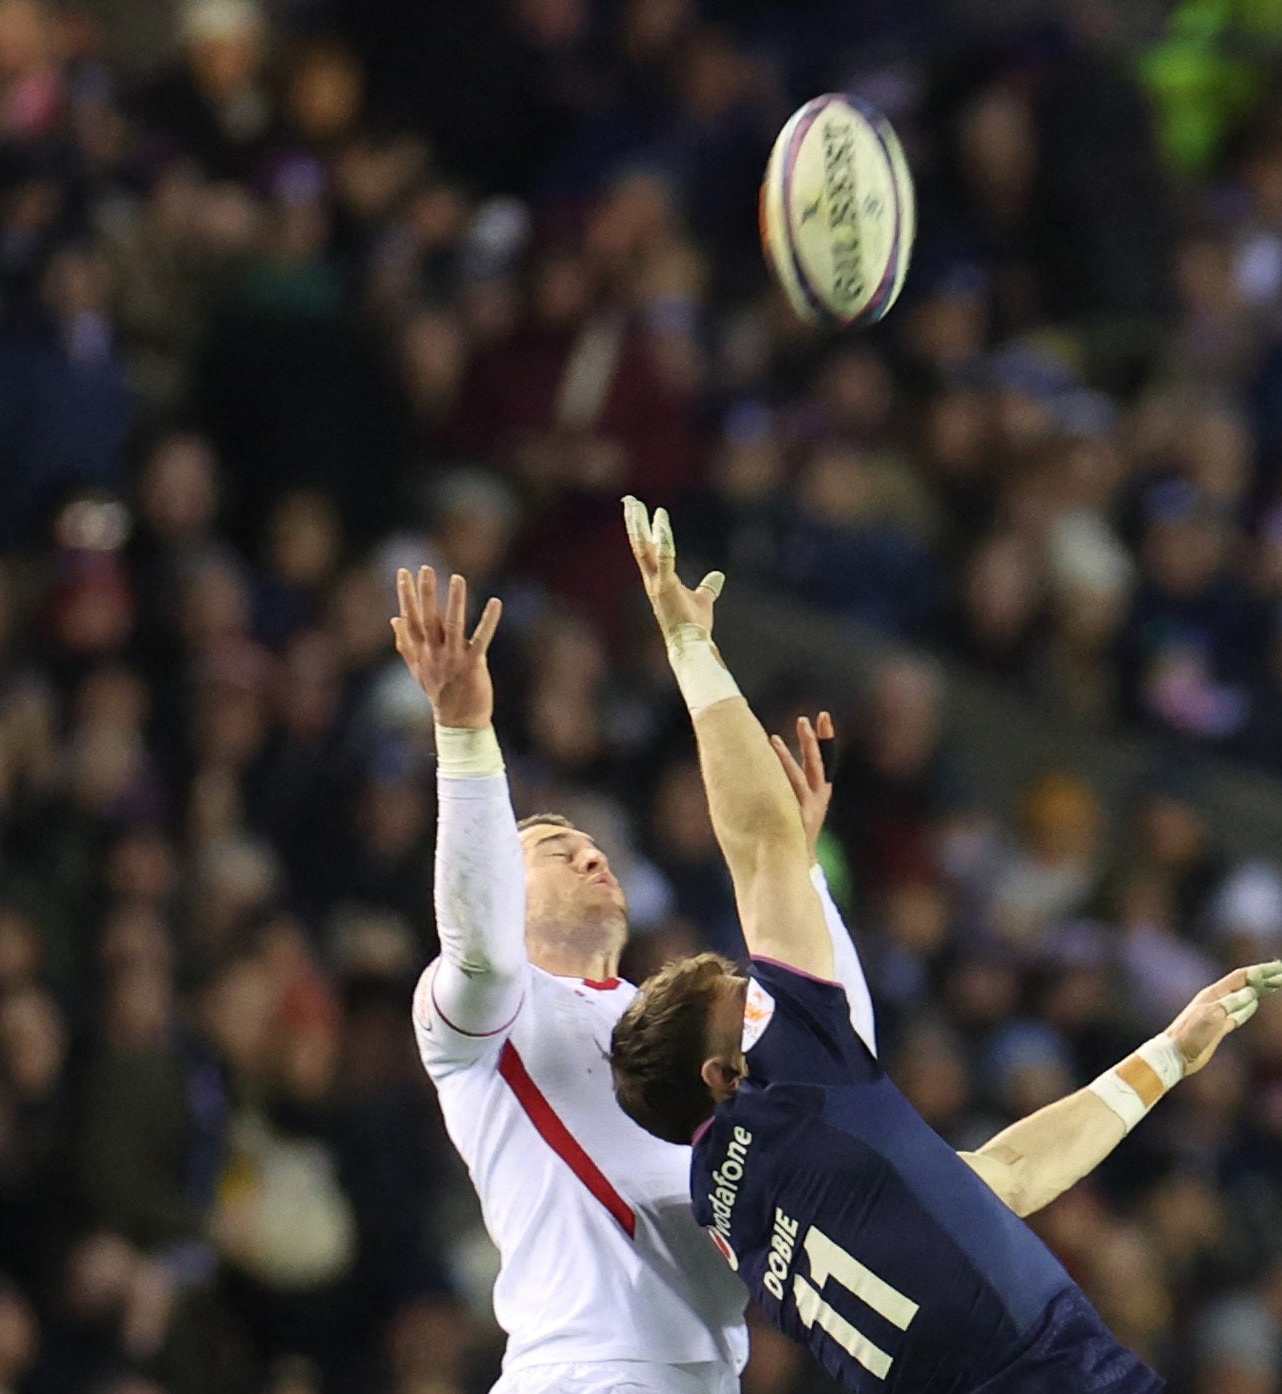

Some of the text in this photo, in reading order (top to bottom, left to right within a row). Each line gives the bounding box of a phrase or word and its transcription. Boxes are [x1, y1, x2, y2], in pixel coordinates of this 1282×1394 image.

[708, 1125, 753, 1238] vodafone
[763, 1206, 800, 1301] DOBIE
[793, 1224, 920, 1381] 11
